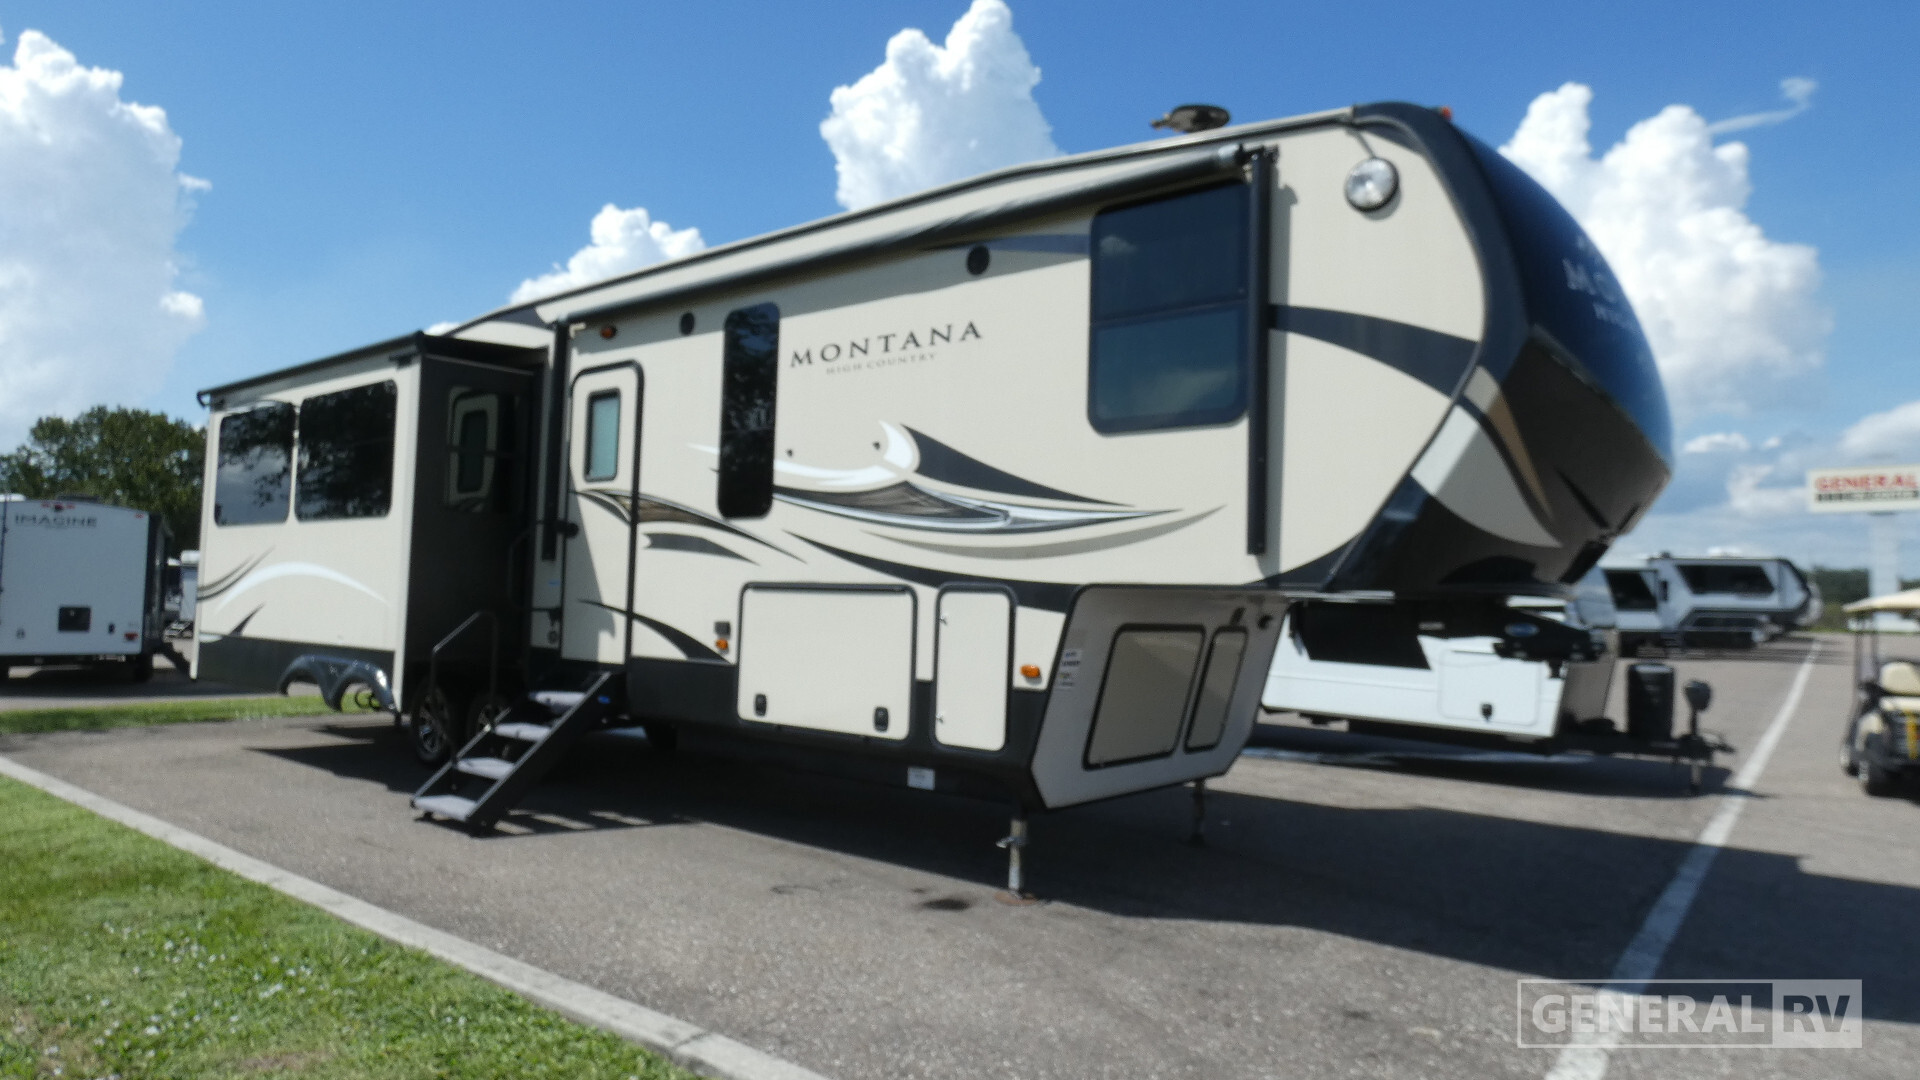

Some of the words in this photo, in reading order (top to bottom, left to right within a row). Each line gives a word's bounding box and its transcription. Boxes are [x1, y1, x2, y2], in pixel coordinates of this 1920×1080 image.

[790, 320, 982, 368] MONTANA
[826, 362, 862, 376] HIGH
[866, 352, 935, 370] COUNTRY
[1816, 475, 1917, 491] GENERAL
[15, 513, 97, 527] IMAGINE
